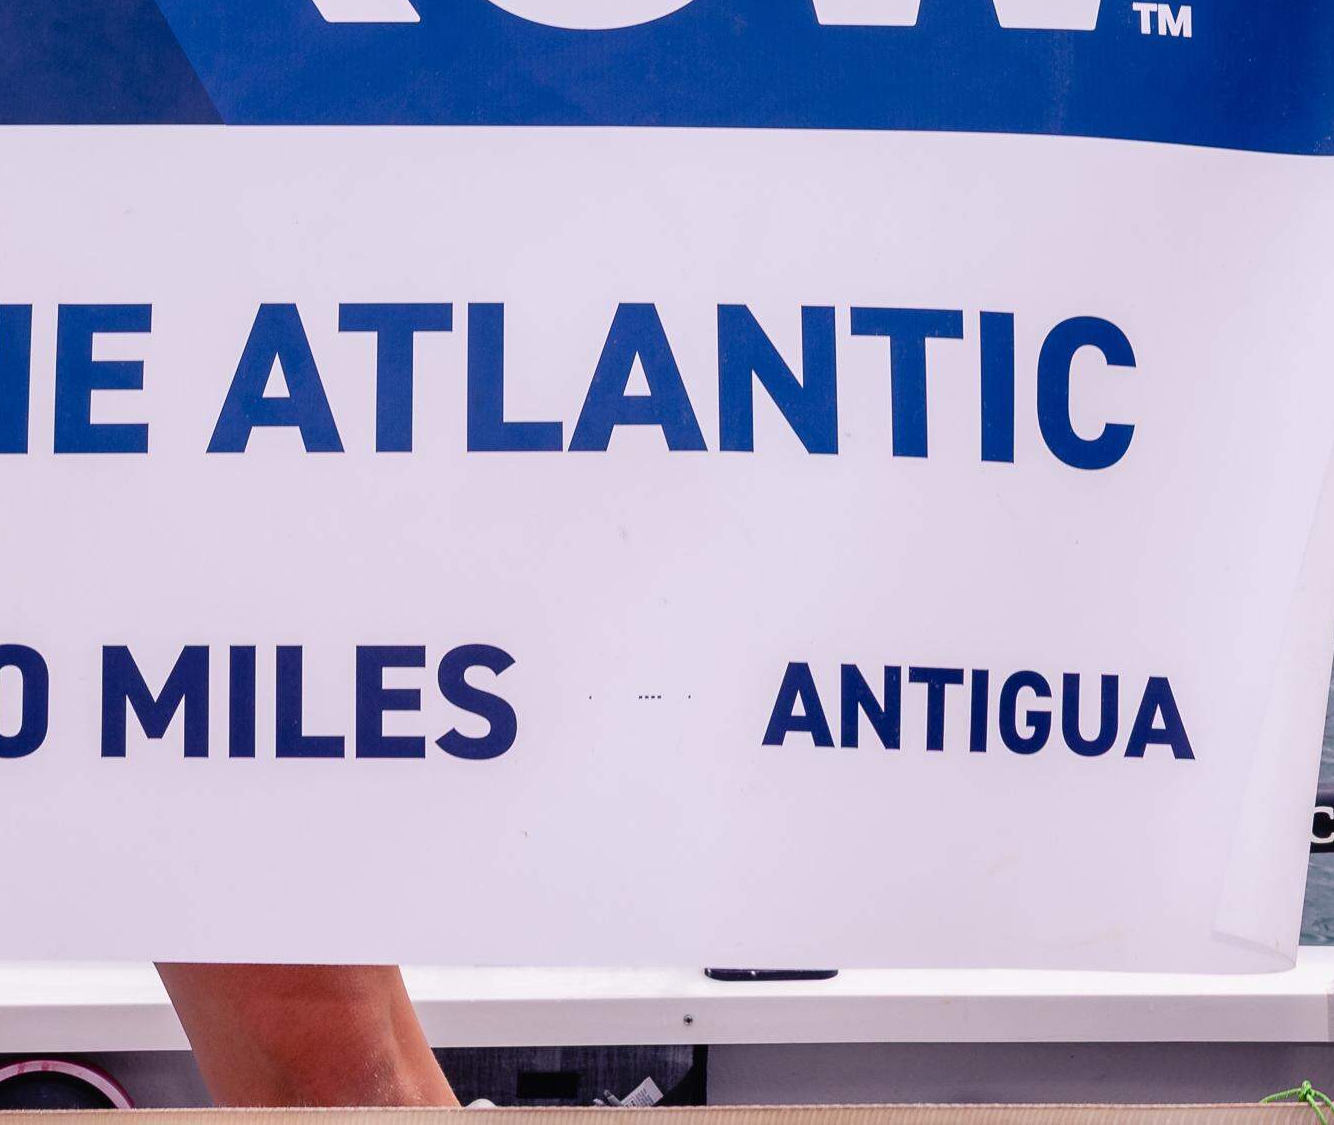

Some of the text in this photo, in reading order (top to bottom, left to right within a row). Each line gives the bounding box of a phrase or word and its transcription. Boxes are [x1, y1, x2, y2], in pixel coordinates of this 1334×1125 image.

[206, 303, 1136, 471] ATLANTIC
[101, 644, 517, 761] MILES
[762, 662, 1195, 761] ANTIGUA
